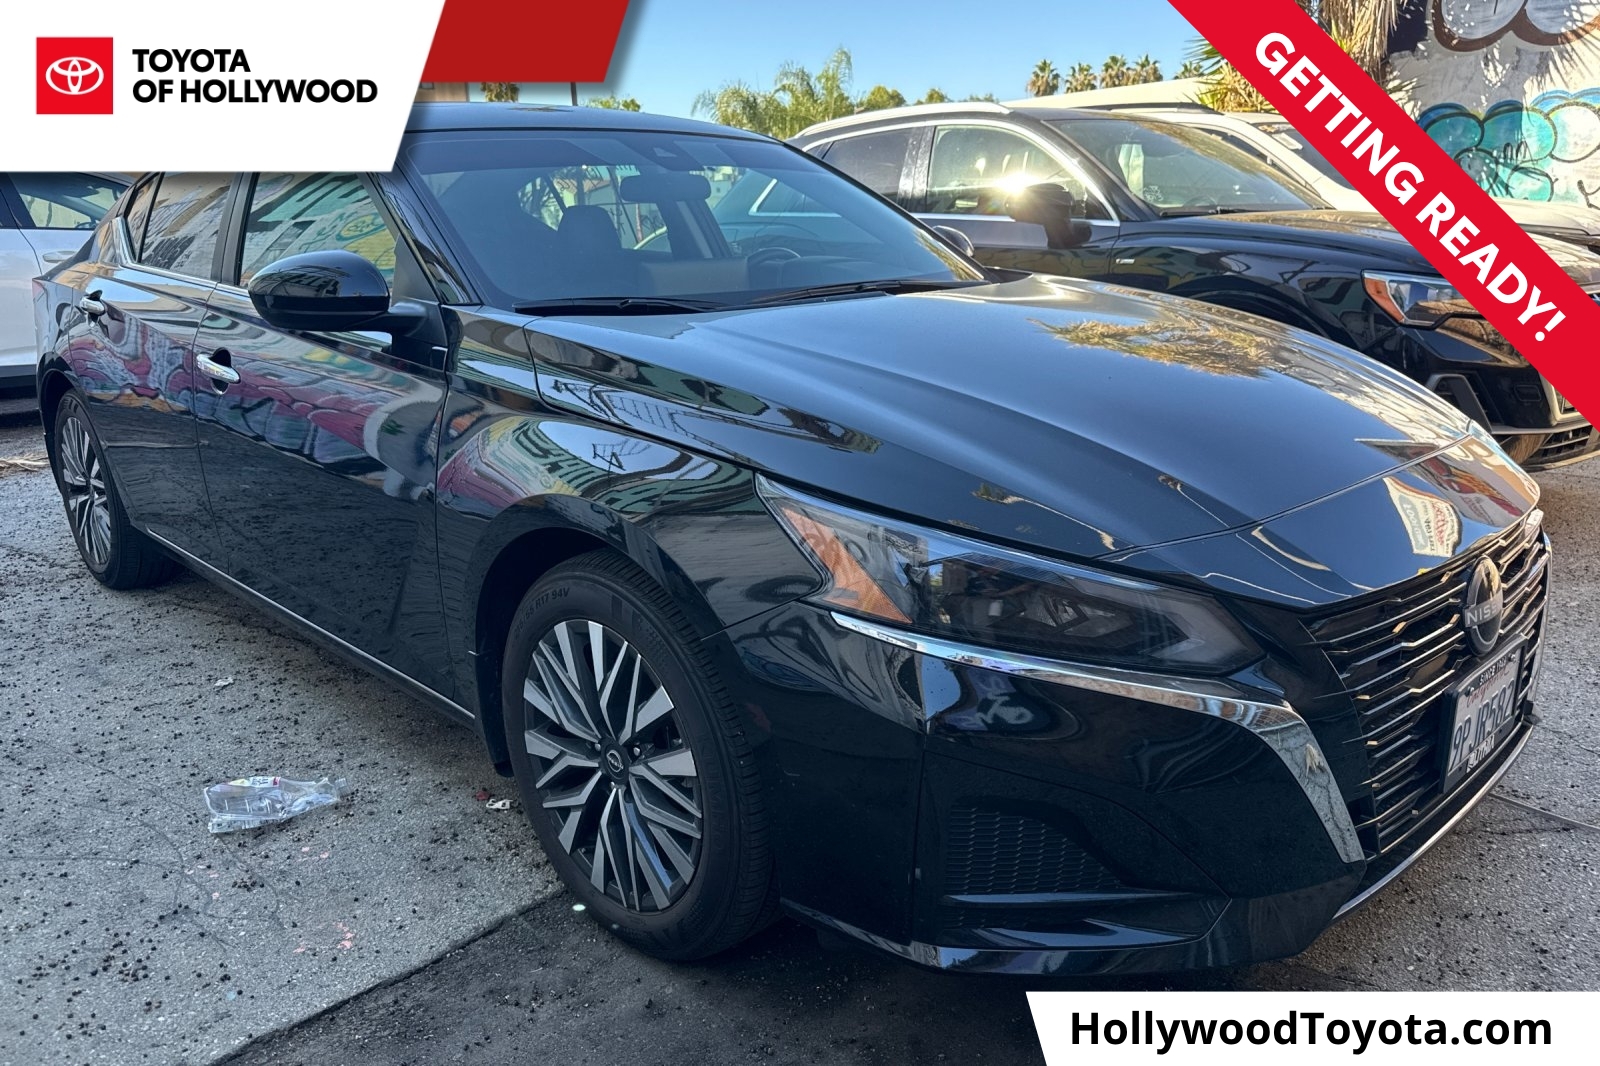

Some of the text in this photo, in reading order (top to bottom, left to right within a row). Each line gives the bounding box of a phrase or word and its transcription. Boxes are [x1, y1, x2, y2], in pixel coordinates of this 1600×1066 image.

[551, 587, 570, 600] 94V
[1466, 600, 1500, 625] NISS
[1449, 678, 1515, 772] 9PJR582
